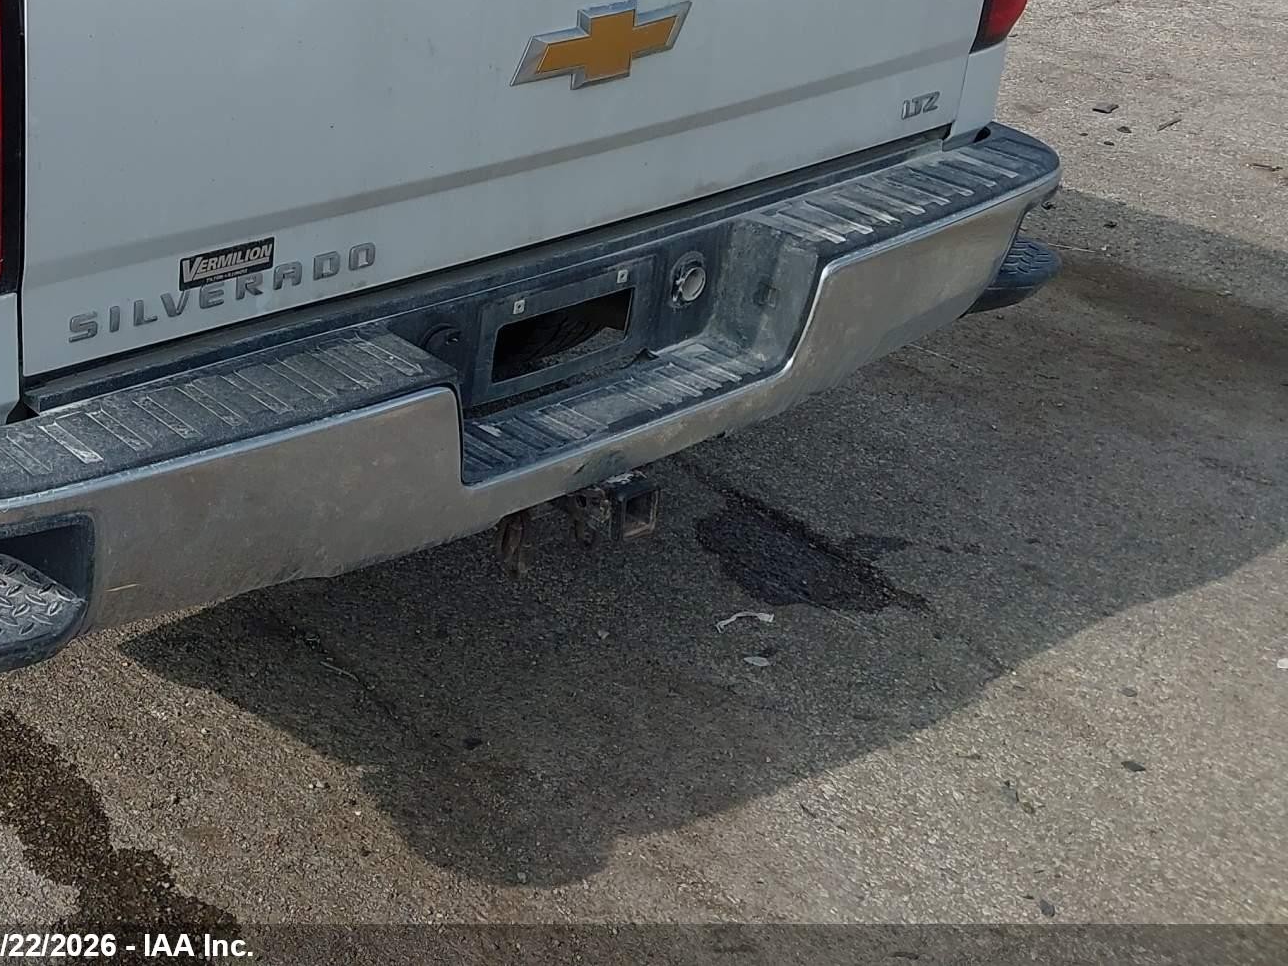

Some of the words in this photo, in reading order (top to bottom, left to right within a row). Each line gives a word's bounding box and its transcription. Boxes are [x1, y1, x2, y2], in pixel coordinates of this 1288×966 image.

[901, 90, 941, 120] LTZ
[182, 243, 273, 283] VERMILION
[68, 241, 376, 343] SILVERADO
